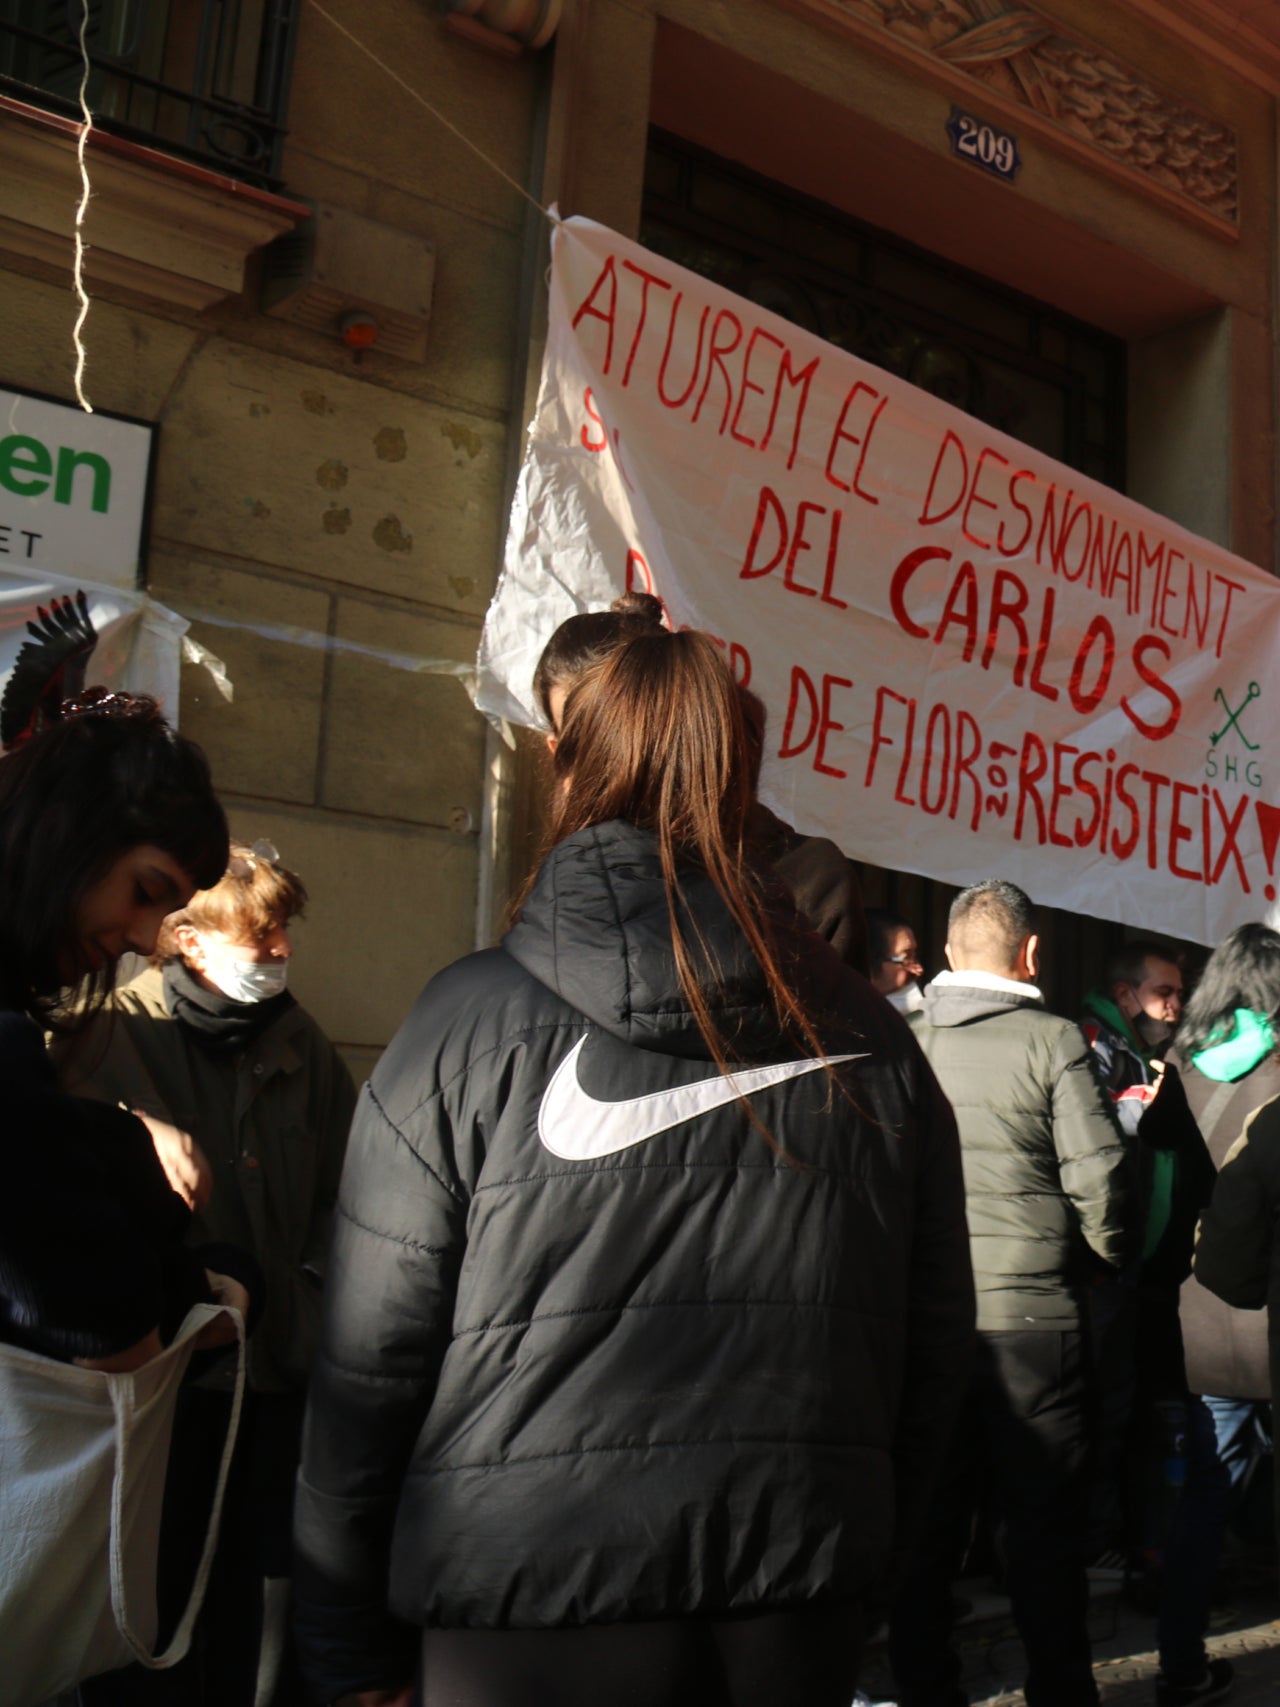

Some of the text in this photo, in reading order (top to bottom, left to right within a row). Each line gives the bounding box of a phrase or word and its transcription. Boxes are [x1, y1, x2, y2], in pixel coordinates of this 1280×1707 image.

[957, 116, 1014, 173] 209
[571, 254, 821, 471] ATUREM
[825, 380, 889, 505] EL
[917, 428, 1246, 659] DESNONAMENT
[739, 485, 847, 611] DEL
[888, 545, 1183, 742] CARLOS
[777, 664, 853, 779] DE
[863, 685, 983, 833] FLOR
